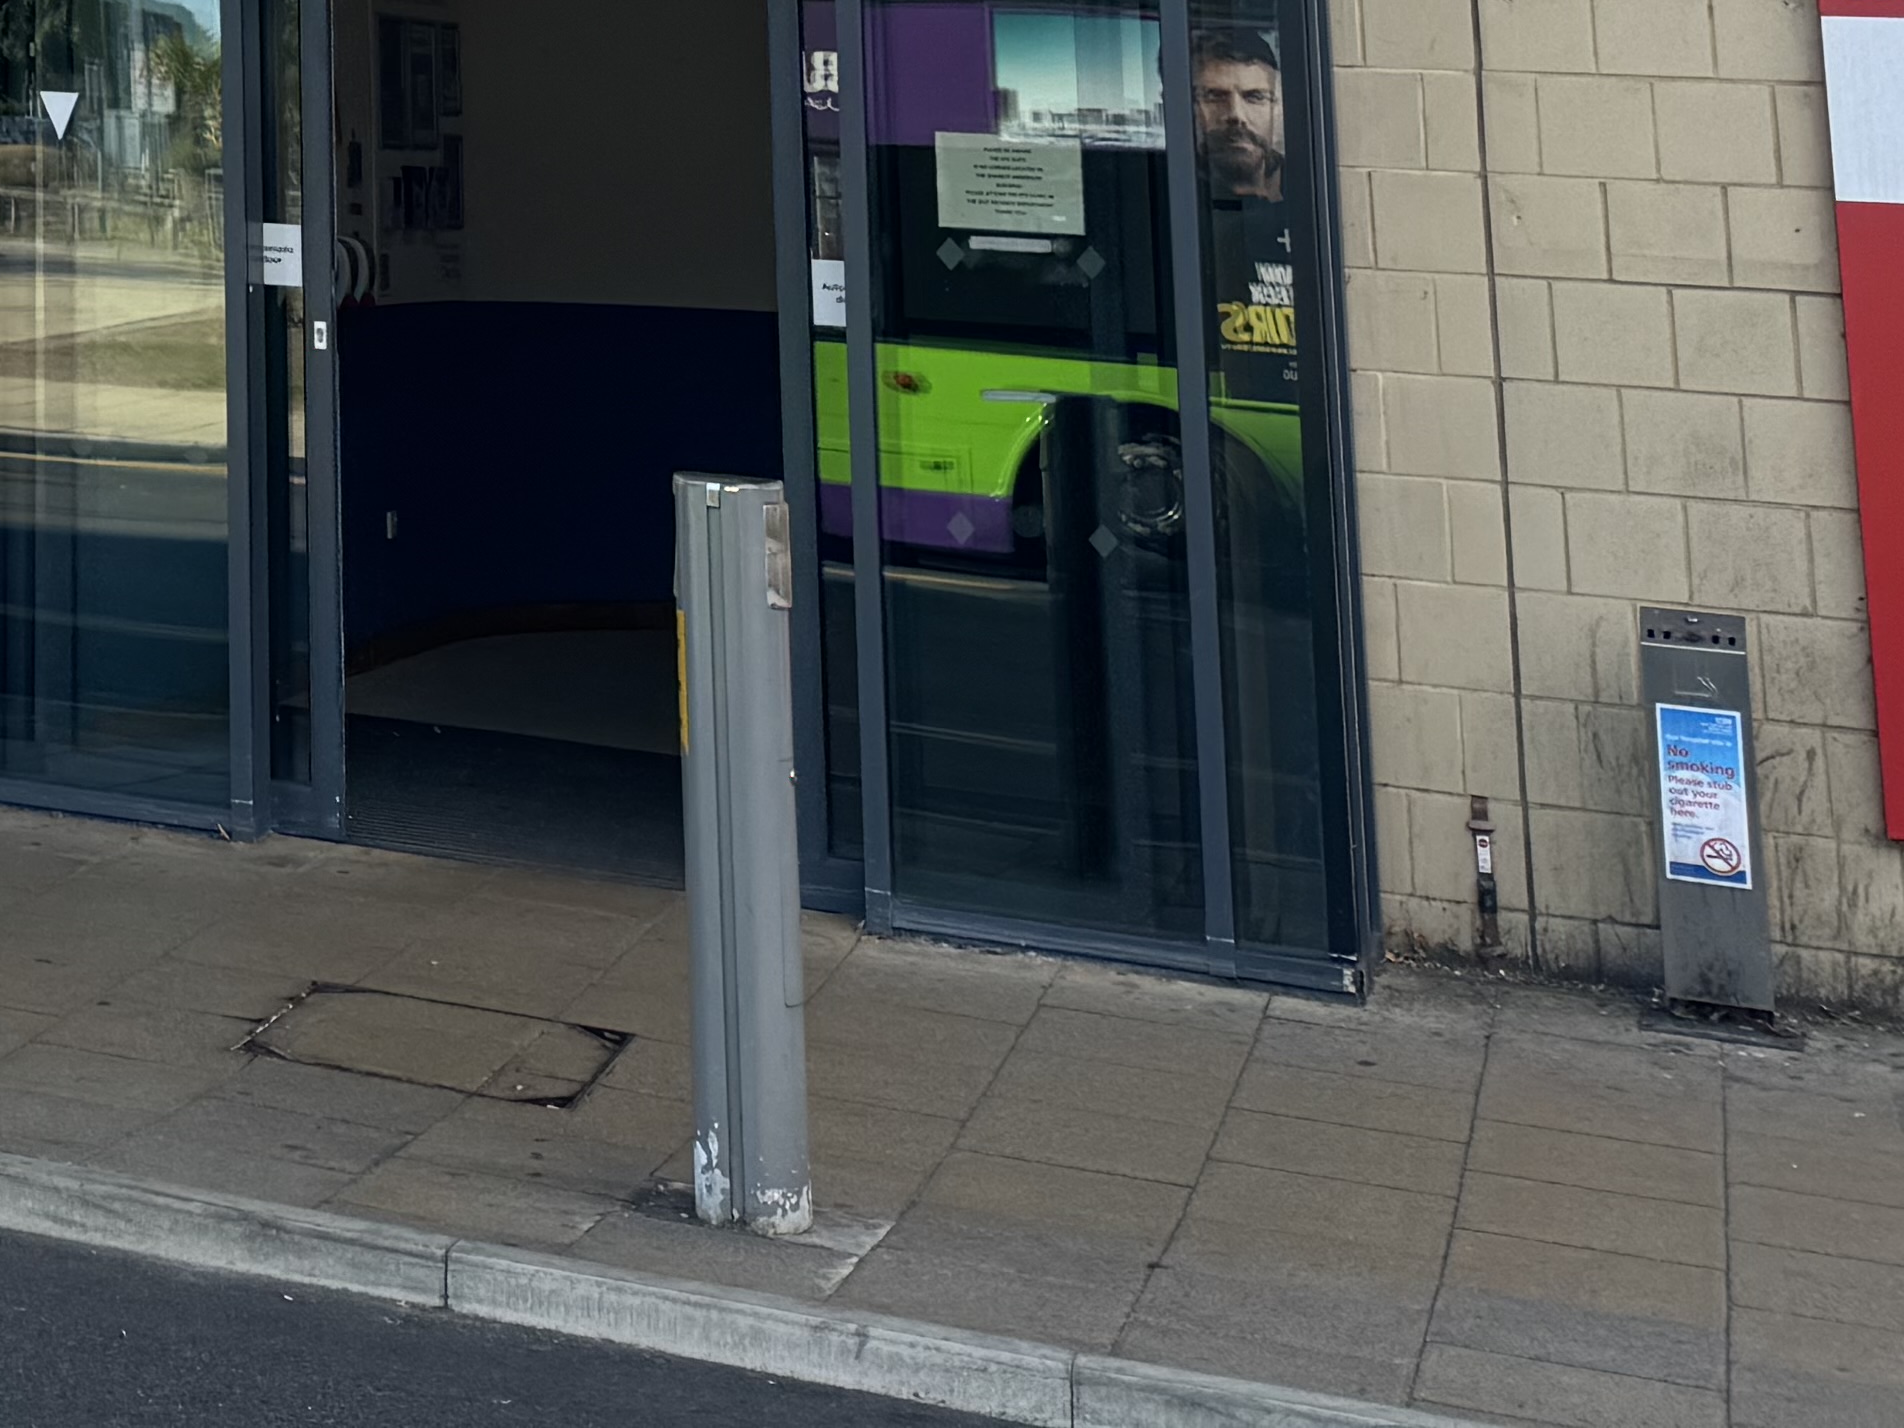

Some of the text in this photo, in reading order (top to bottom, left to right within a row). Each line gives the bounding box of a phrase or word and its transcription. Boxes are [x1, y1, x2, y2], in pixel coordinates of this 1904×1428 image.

[1667, 744, 1689, 758] No
[1667, 761, 1736, 780] smoking
[1668, 775, 1733, 792] Please stub
[1692, 790, 1718, 801] your
